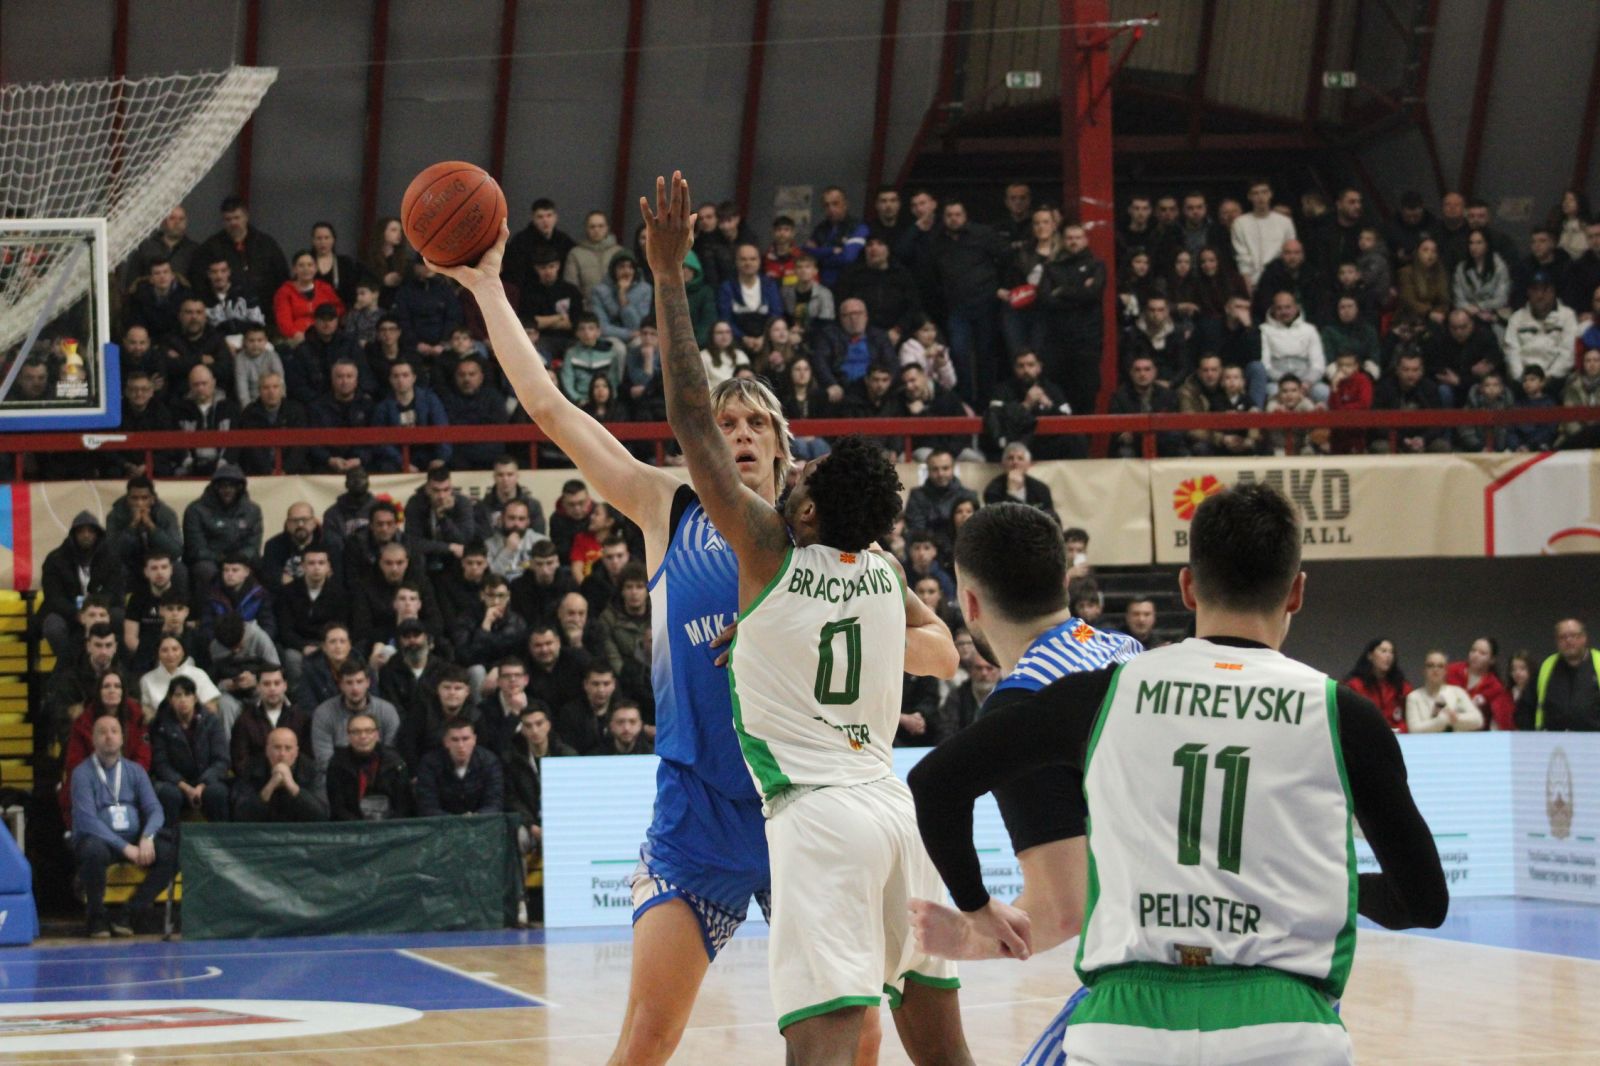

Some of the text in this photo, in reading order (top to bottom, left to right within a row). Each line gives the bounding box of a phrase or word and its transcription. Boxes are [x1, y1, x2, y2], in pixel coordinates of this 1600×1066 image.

[814, 617, 861, 705] 0
[1135, 680, 1305, 725] MITREVSKI
[1172, 742, 1251, 875] 11
[1139, 893, 1261, 934] PELISTER
